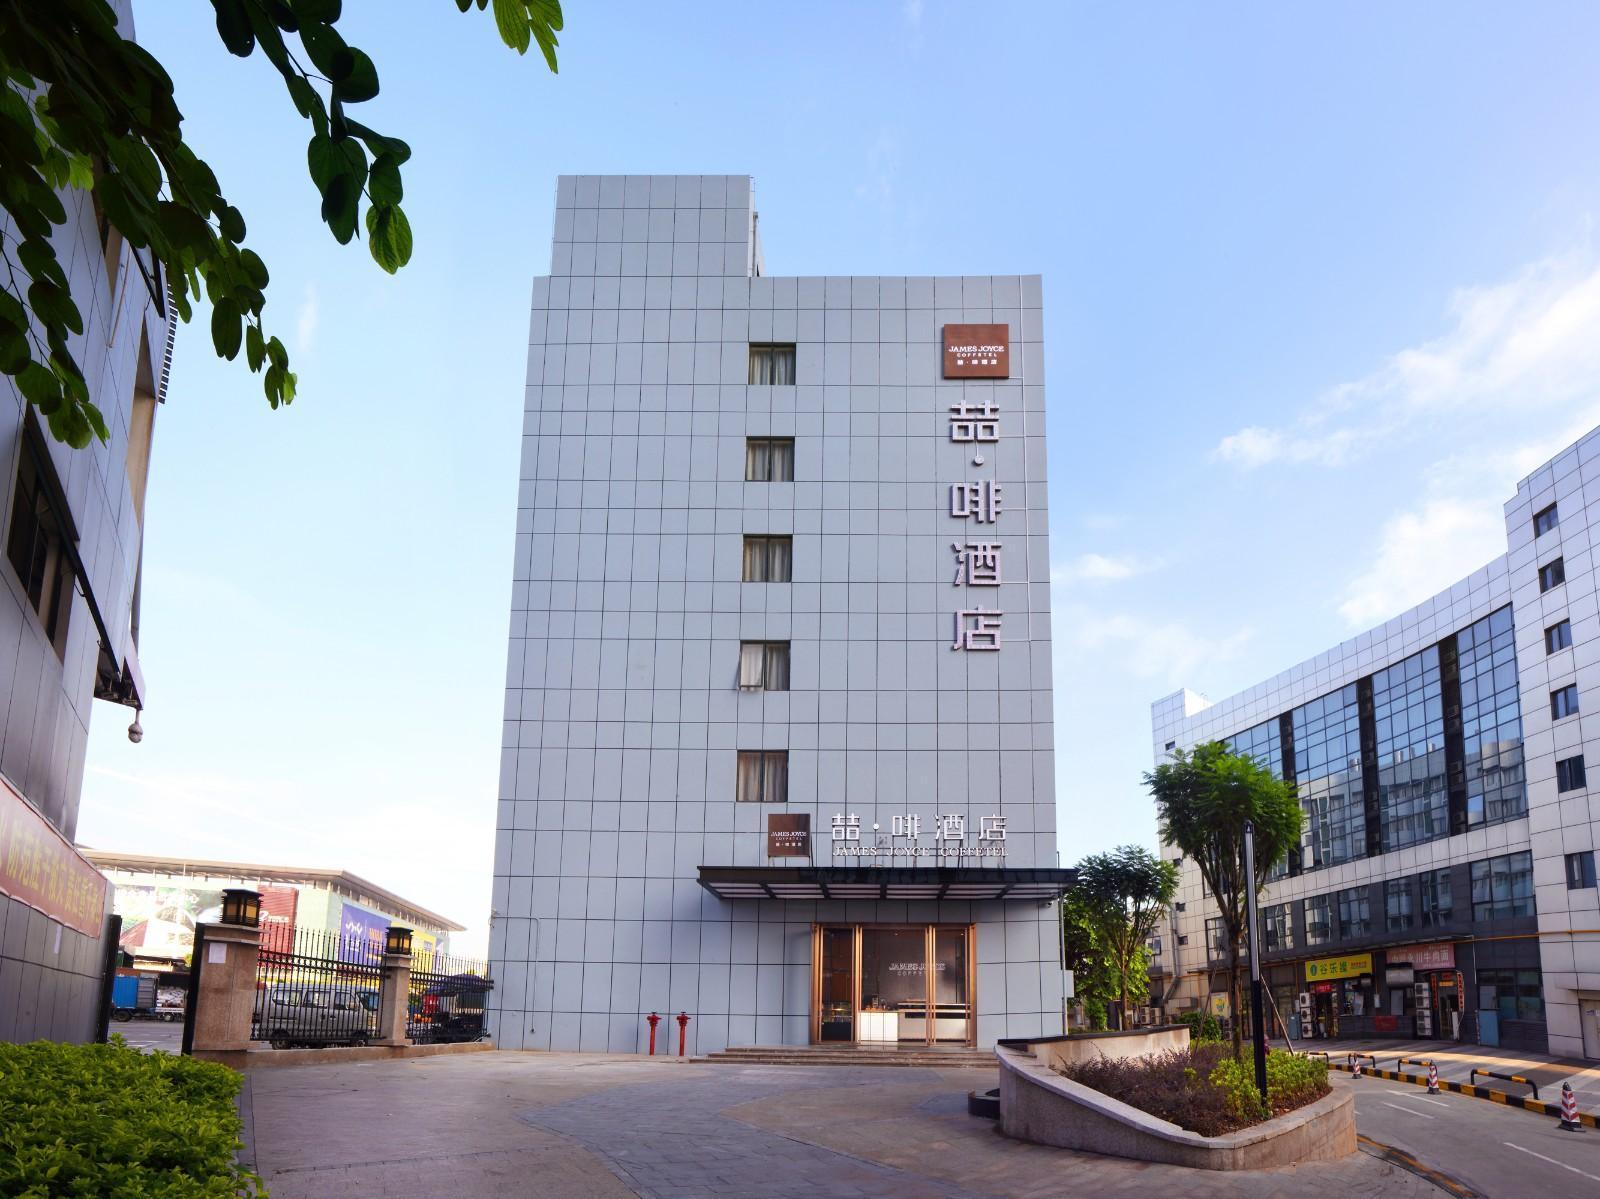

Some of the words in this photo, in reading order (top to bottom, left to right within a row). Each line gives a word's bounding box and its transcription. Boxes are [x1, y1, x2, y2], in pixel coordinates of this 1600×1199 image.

[949, 345, 977, 353] JAMES
[832, 846, 877, 857] JAMES
[886, 846, 930, 857] JOYCE
[940, 846, 1008, 857] COFFETEL
